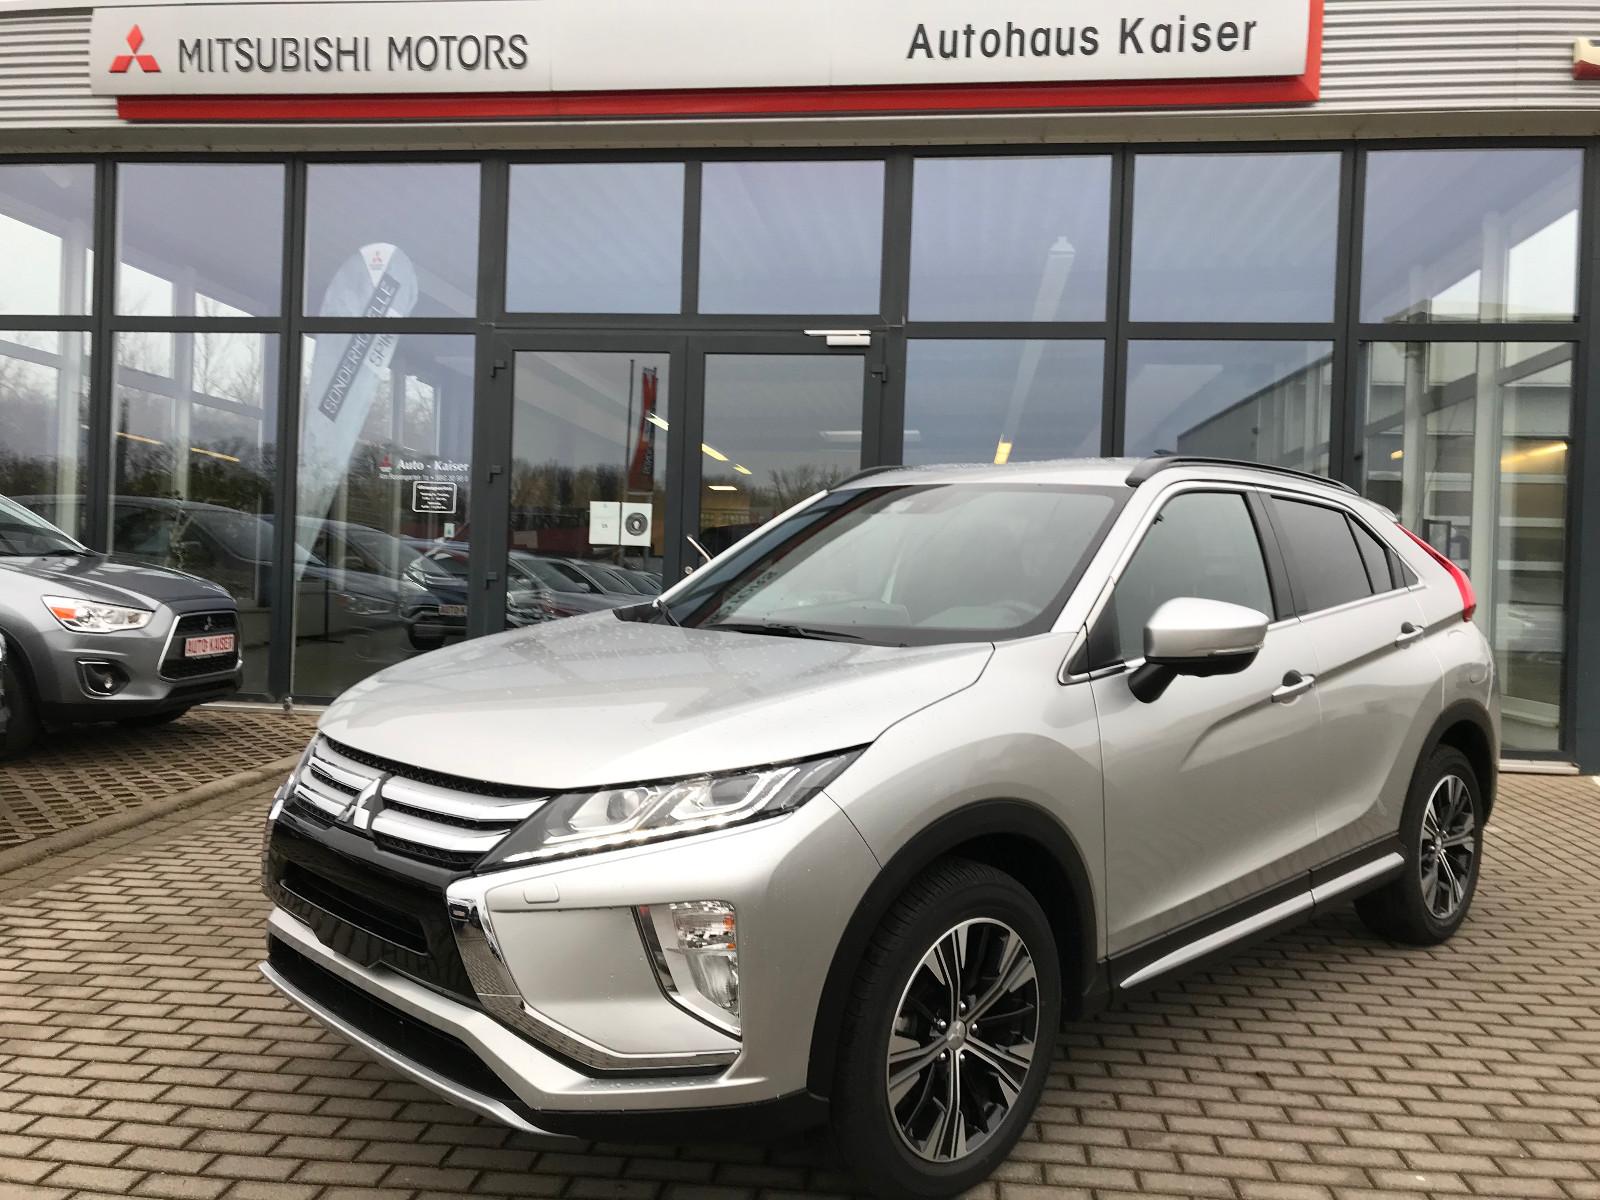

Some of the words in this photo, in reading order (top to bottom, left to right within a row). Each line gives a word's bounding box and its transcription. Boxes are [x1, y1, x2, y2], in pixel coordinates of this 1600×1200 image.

[906, 21, 1100, 59] Autohaus
[1118, 15, 1257, 54] Kaiser
[178, 36, 370, 73] MITSUBISHI
[387, 34, 529, 71] MOTORS
[398, 459, 424, 471] Auto
[434, 460, 469, 471] Kaiser
[188, 639, 208, 653] AUTO
[210, 636, 232, 650] KAISER
